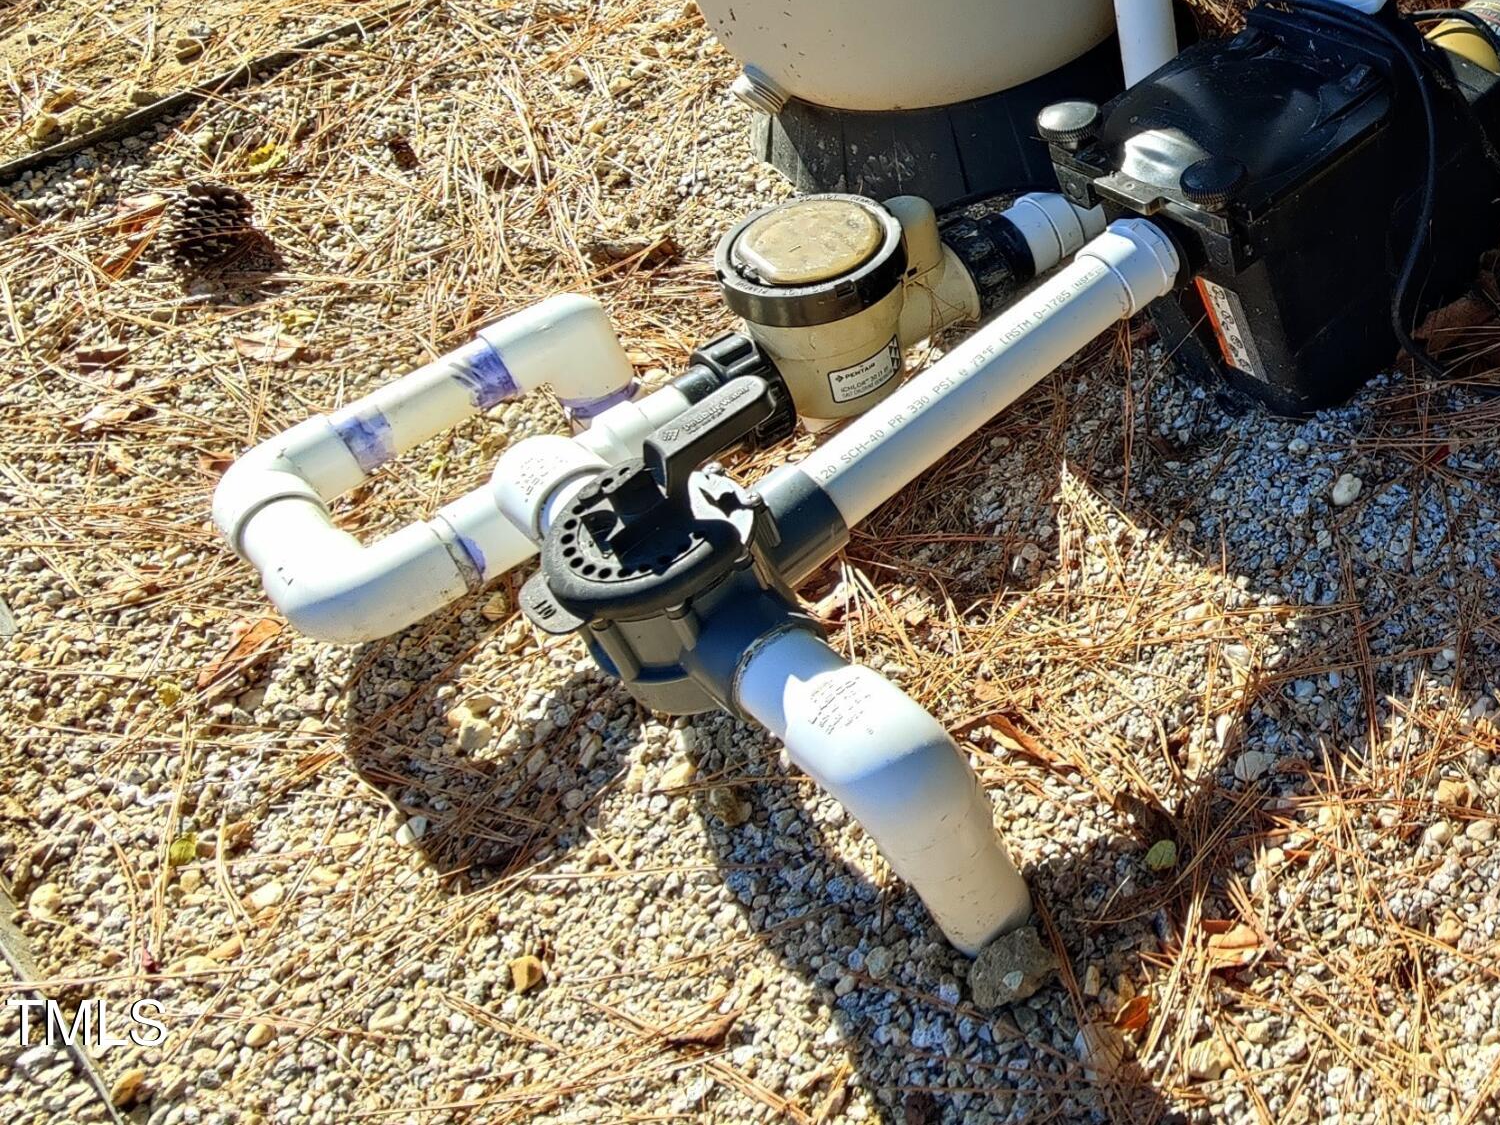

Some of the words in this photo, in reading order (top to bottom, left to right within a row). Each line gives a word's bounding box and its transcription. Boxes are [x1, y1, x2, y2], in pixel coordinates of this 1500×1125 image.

[840, 429, 885, 464] SCH-40
[887, 413, 907, 429] PR
[907, 395, 930, 414] 330
[932, 376, 956, 395] PSI
[1033, 290, 1073, 320] D-1785
